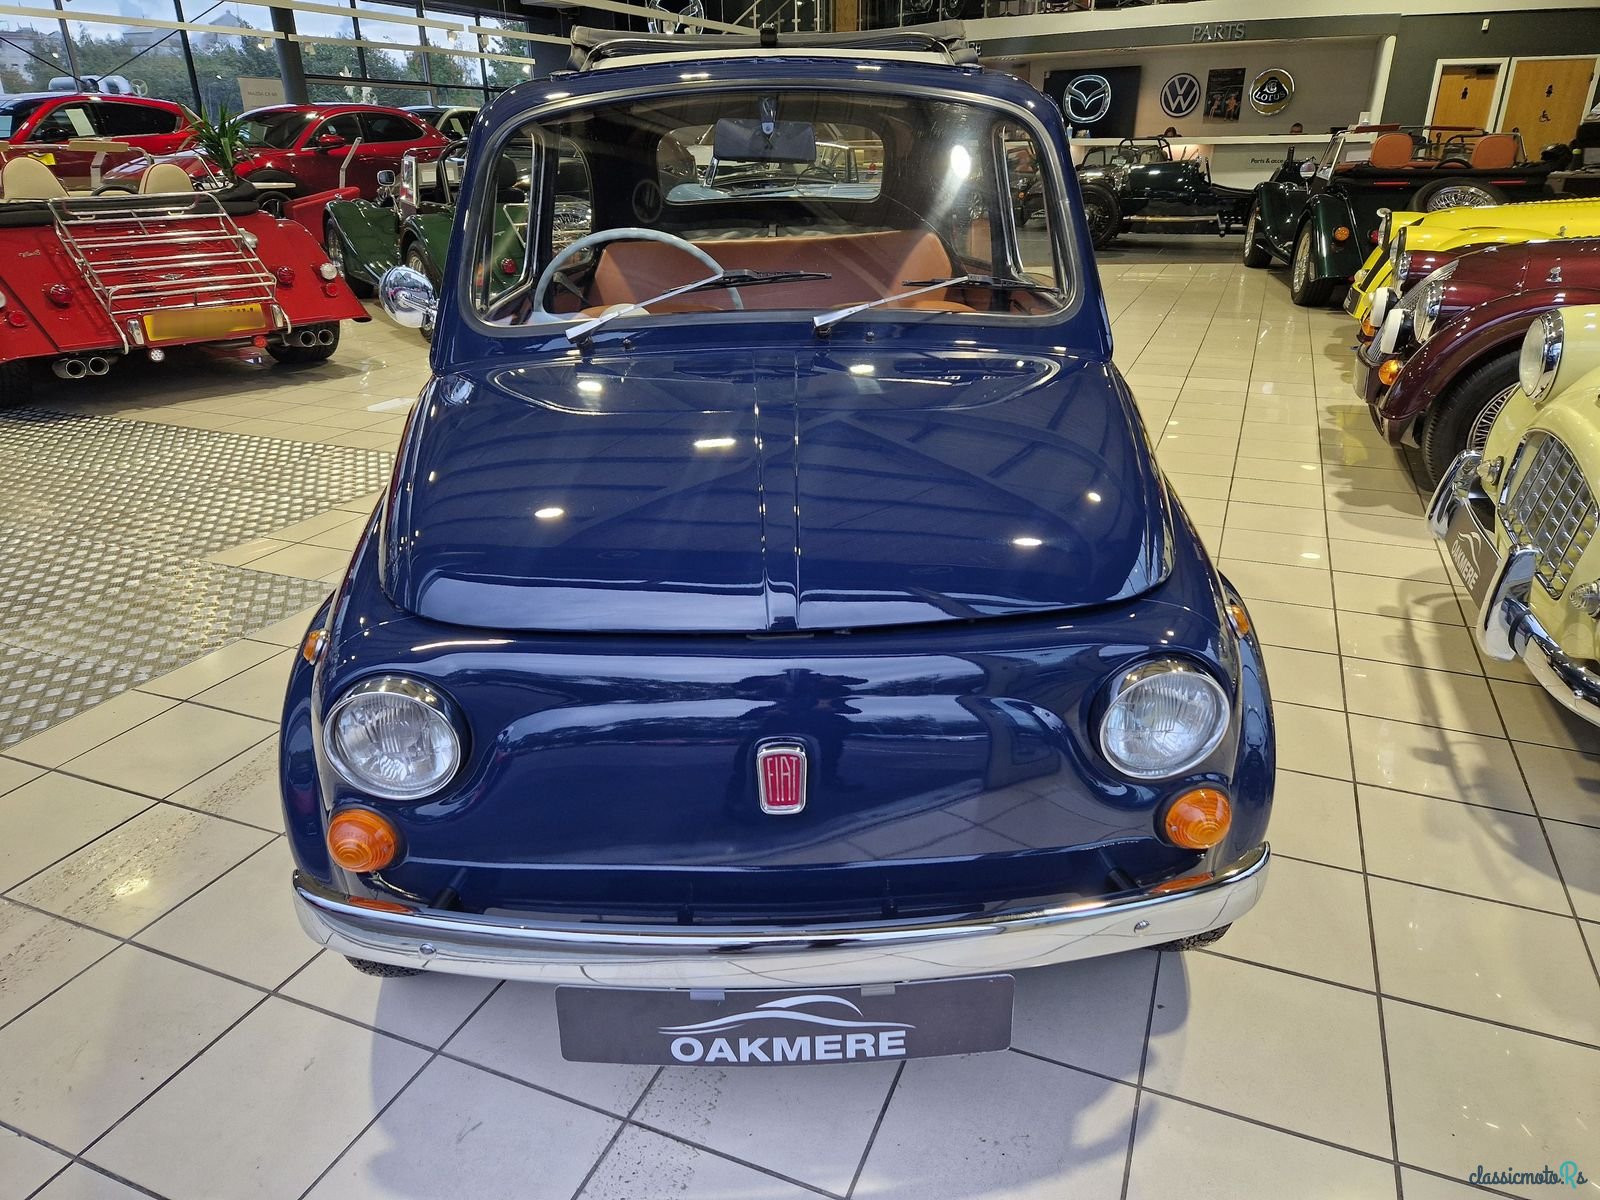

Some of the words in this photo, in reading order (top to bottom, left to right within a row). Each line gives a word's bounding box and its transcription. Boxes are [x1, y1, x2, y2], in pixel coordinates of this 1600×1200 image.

[1191, 23, 1245, 41] PARTS
[1255, 91, 1286, 101] LOTUS
[1451, 539, 1478, 590] OAKMERE
[766, 756, 798, 802] FIAT
[670, 1030, 906, 1063] OAKMERE
